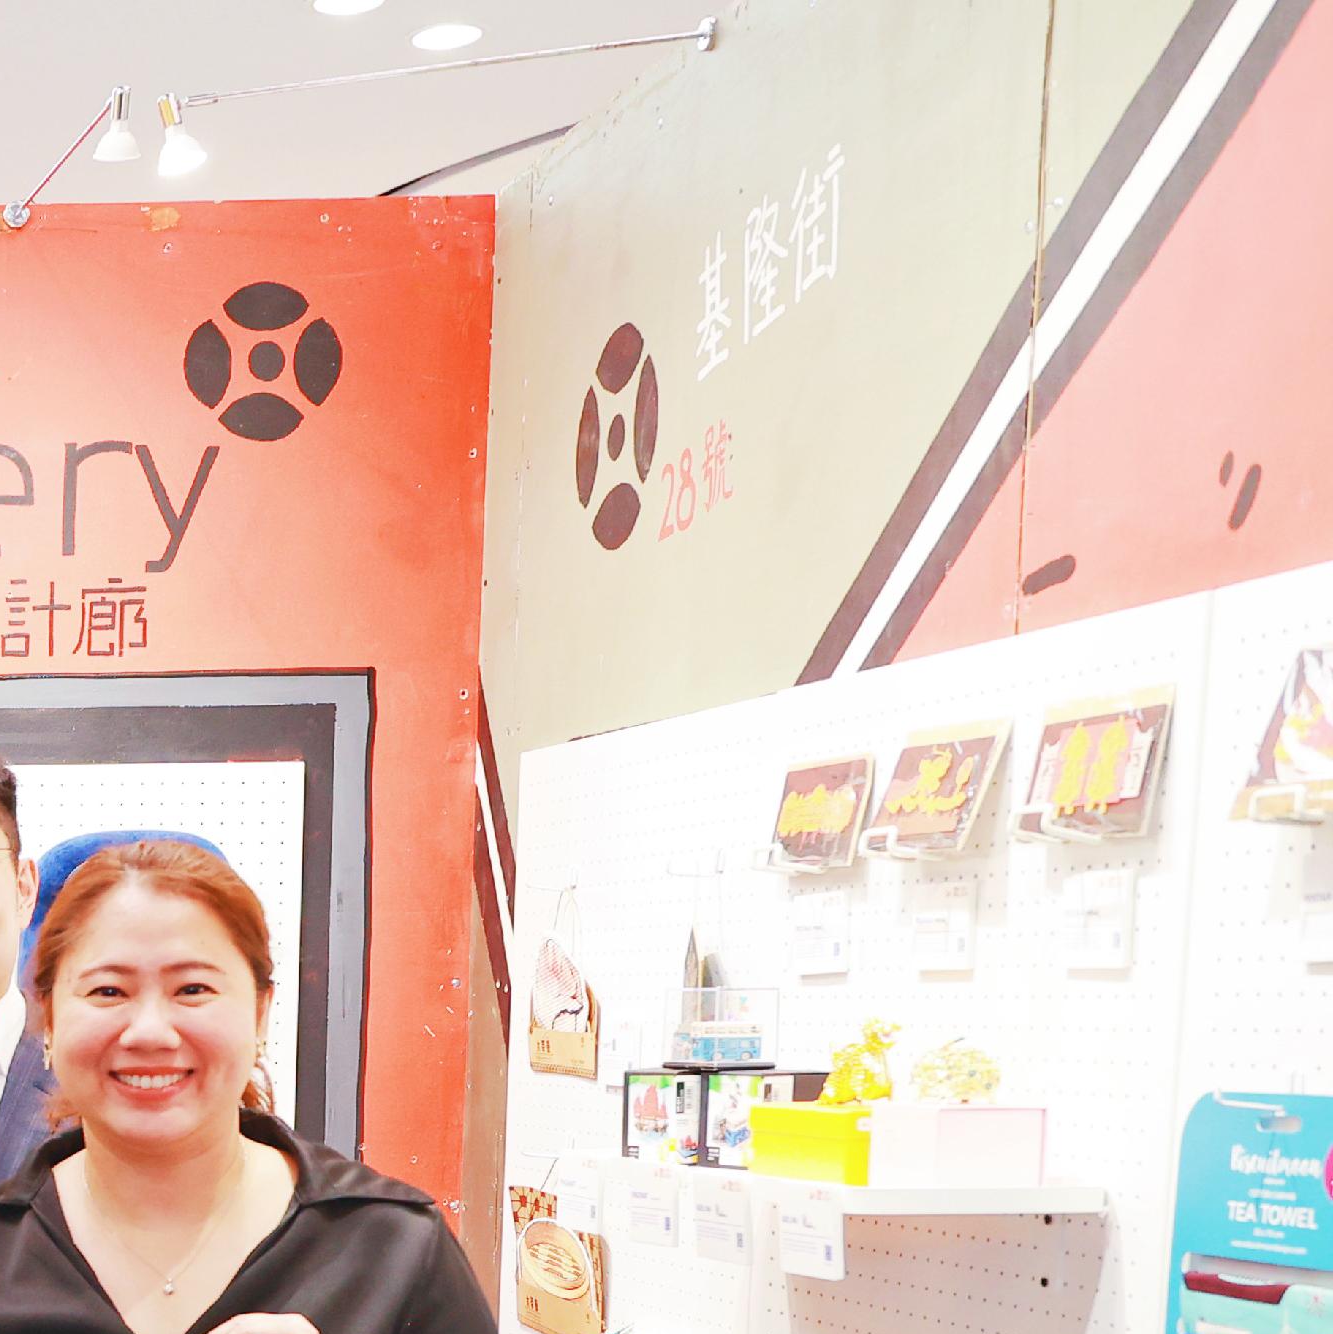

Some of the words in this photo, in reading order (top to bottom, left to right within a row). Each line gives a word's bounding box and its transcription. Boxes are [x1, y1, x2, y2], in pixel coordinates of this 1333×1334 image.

[694, 143, 845, 383] 基隆街
[657, 418, 735, 542] 28號
[1227, 1199, 1258, 1224] TEA
[1260, 1202, 1319, 1231] TOWEL
